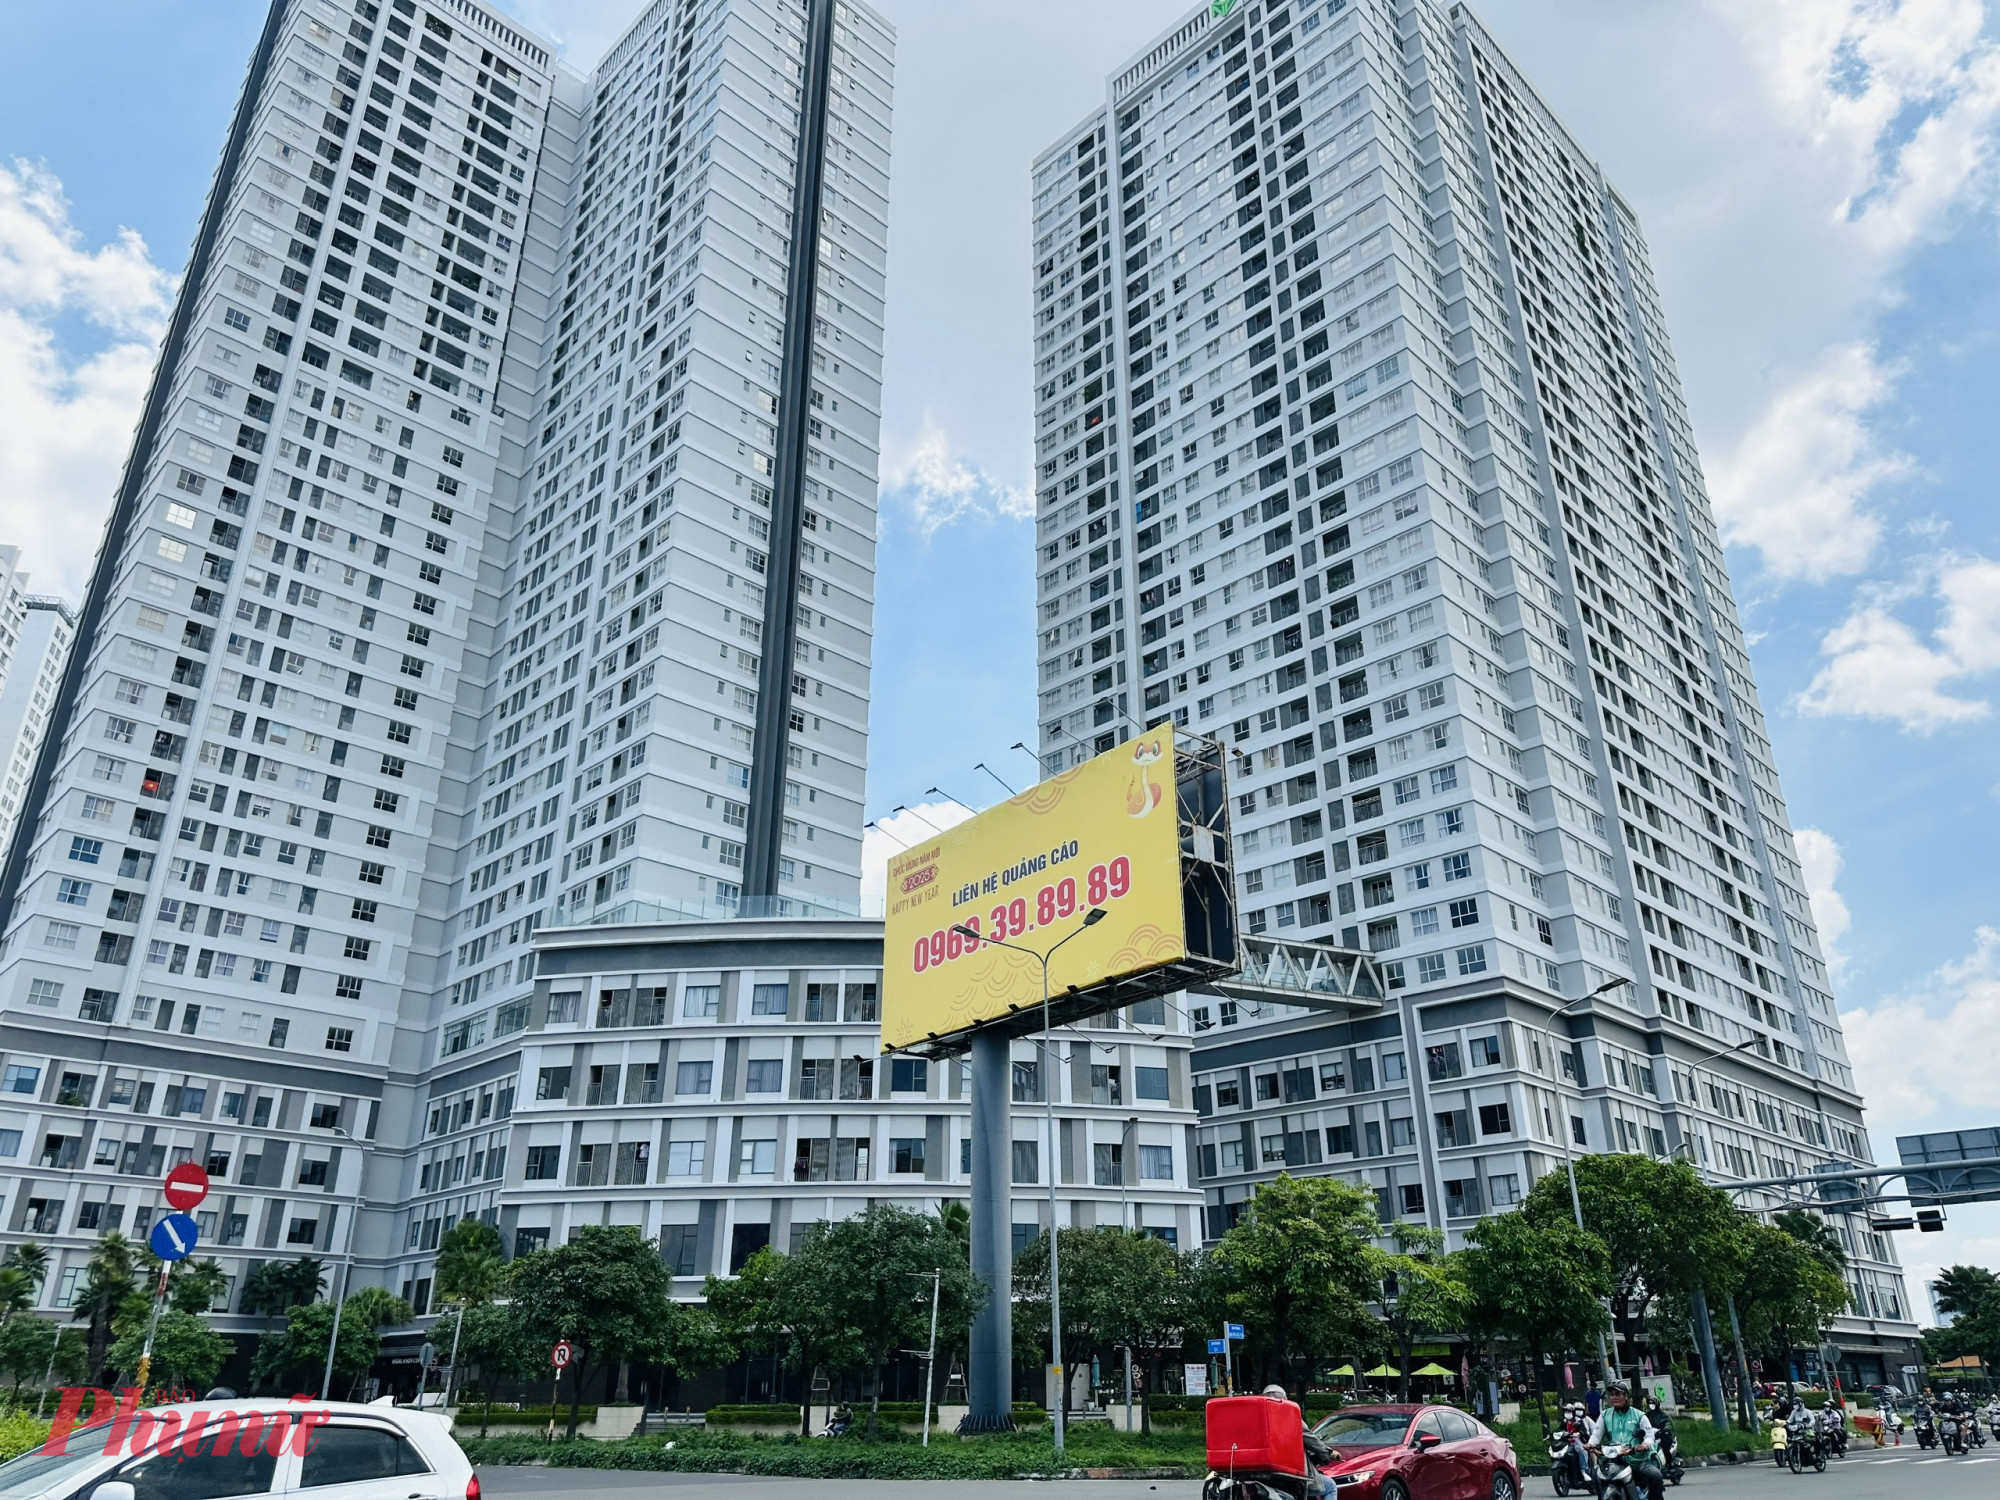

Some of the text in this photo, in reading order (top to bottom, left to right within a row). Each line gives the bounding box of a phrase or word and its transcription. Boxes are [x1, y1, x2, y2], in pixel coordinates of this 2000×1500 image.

[909, 869, 931, 889] 2025
[952, 840, 1079, 907] LIÊN HỆ QUẢNG CÁO
[892, 884, 939, 916] HAPPY NEW YEAR
[913, 855, 1131, 974] 0969.39.89.89
